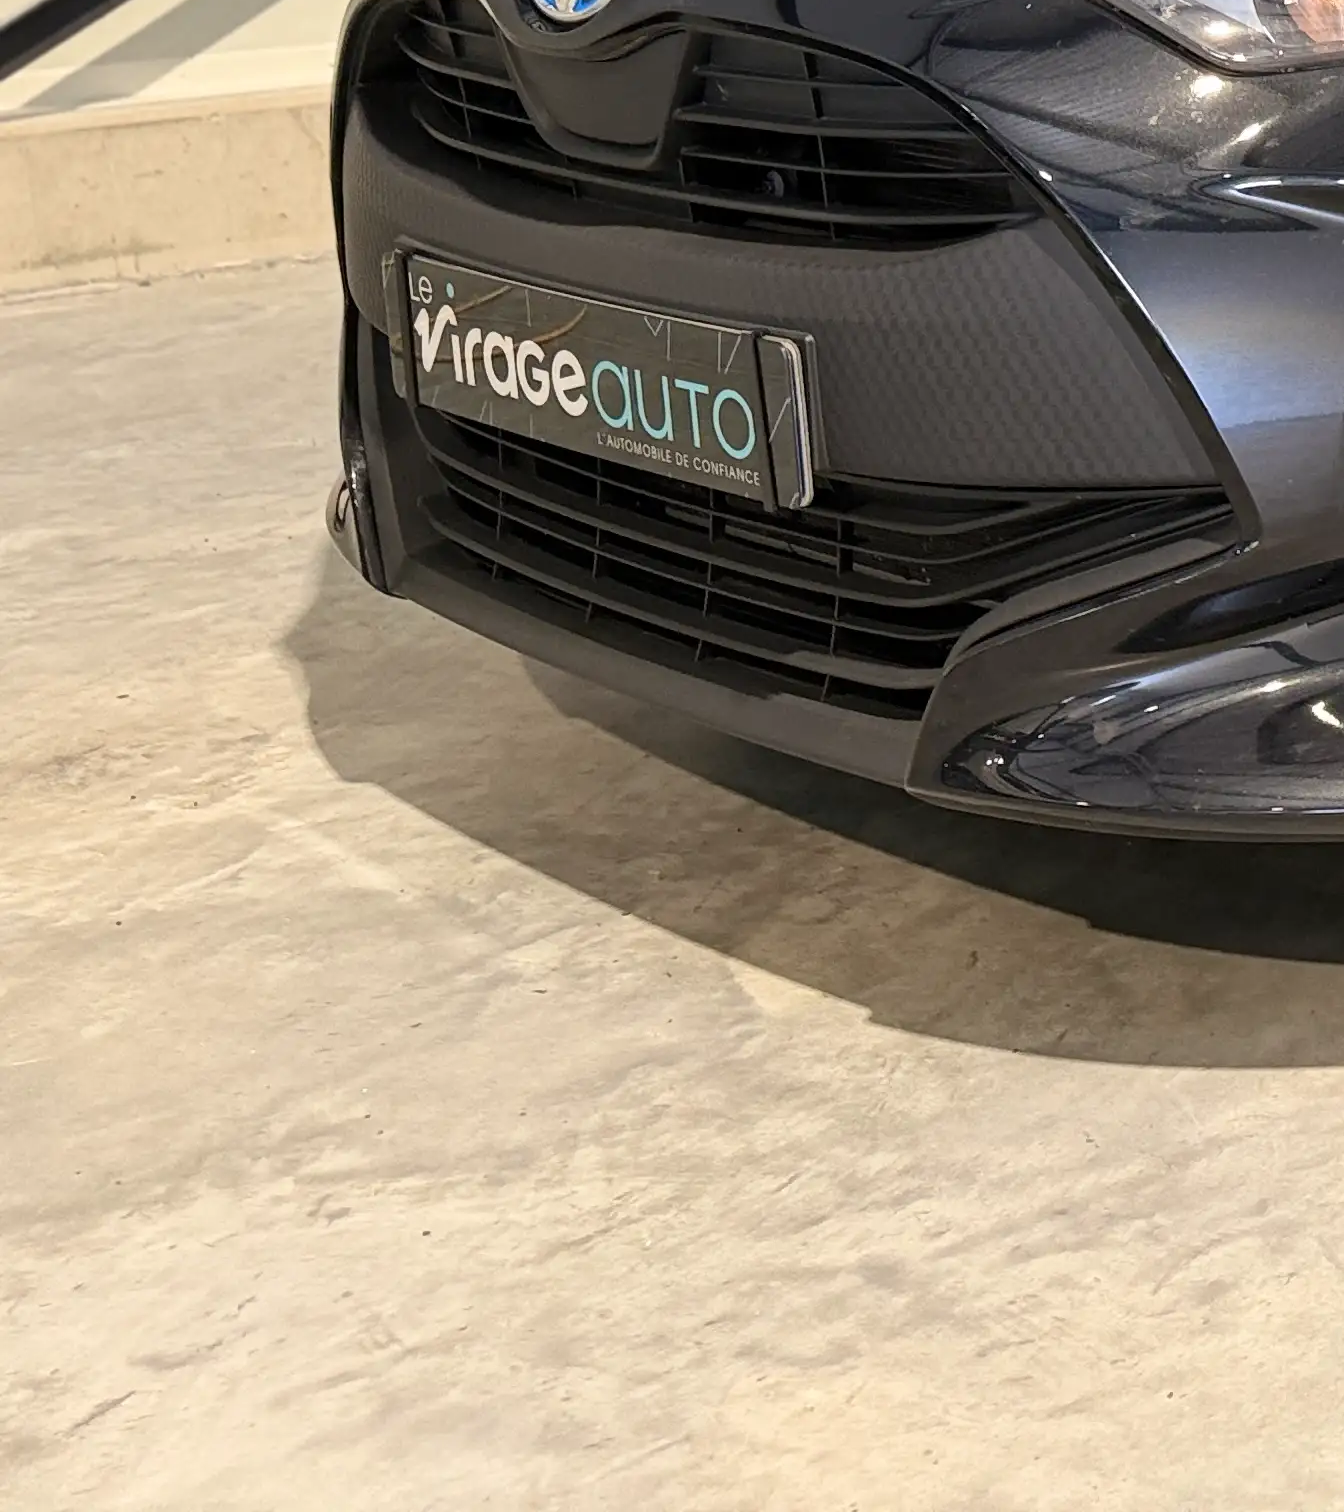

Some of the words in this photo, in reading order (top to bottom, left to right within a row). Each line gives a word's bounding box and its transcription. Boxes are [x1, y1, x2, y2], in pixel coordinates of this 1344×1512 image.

[408, 271, 433, 304] Le
[596, 432, 672, 464] L'AUTOMOBILE
[676, 452, 689, 468] DE
[693, 456, 761, 486] CONFIANCE
